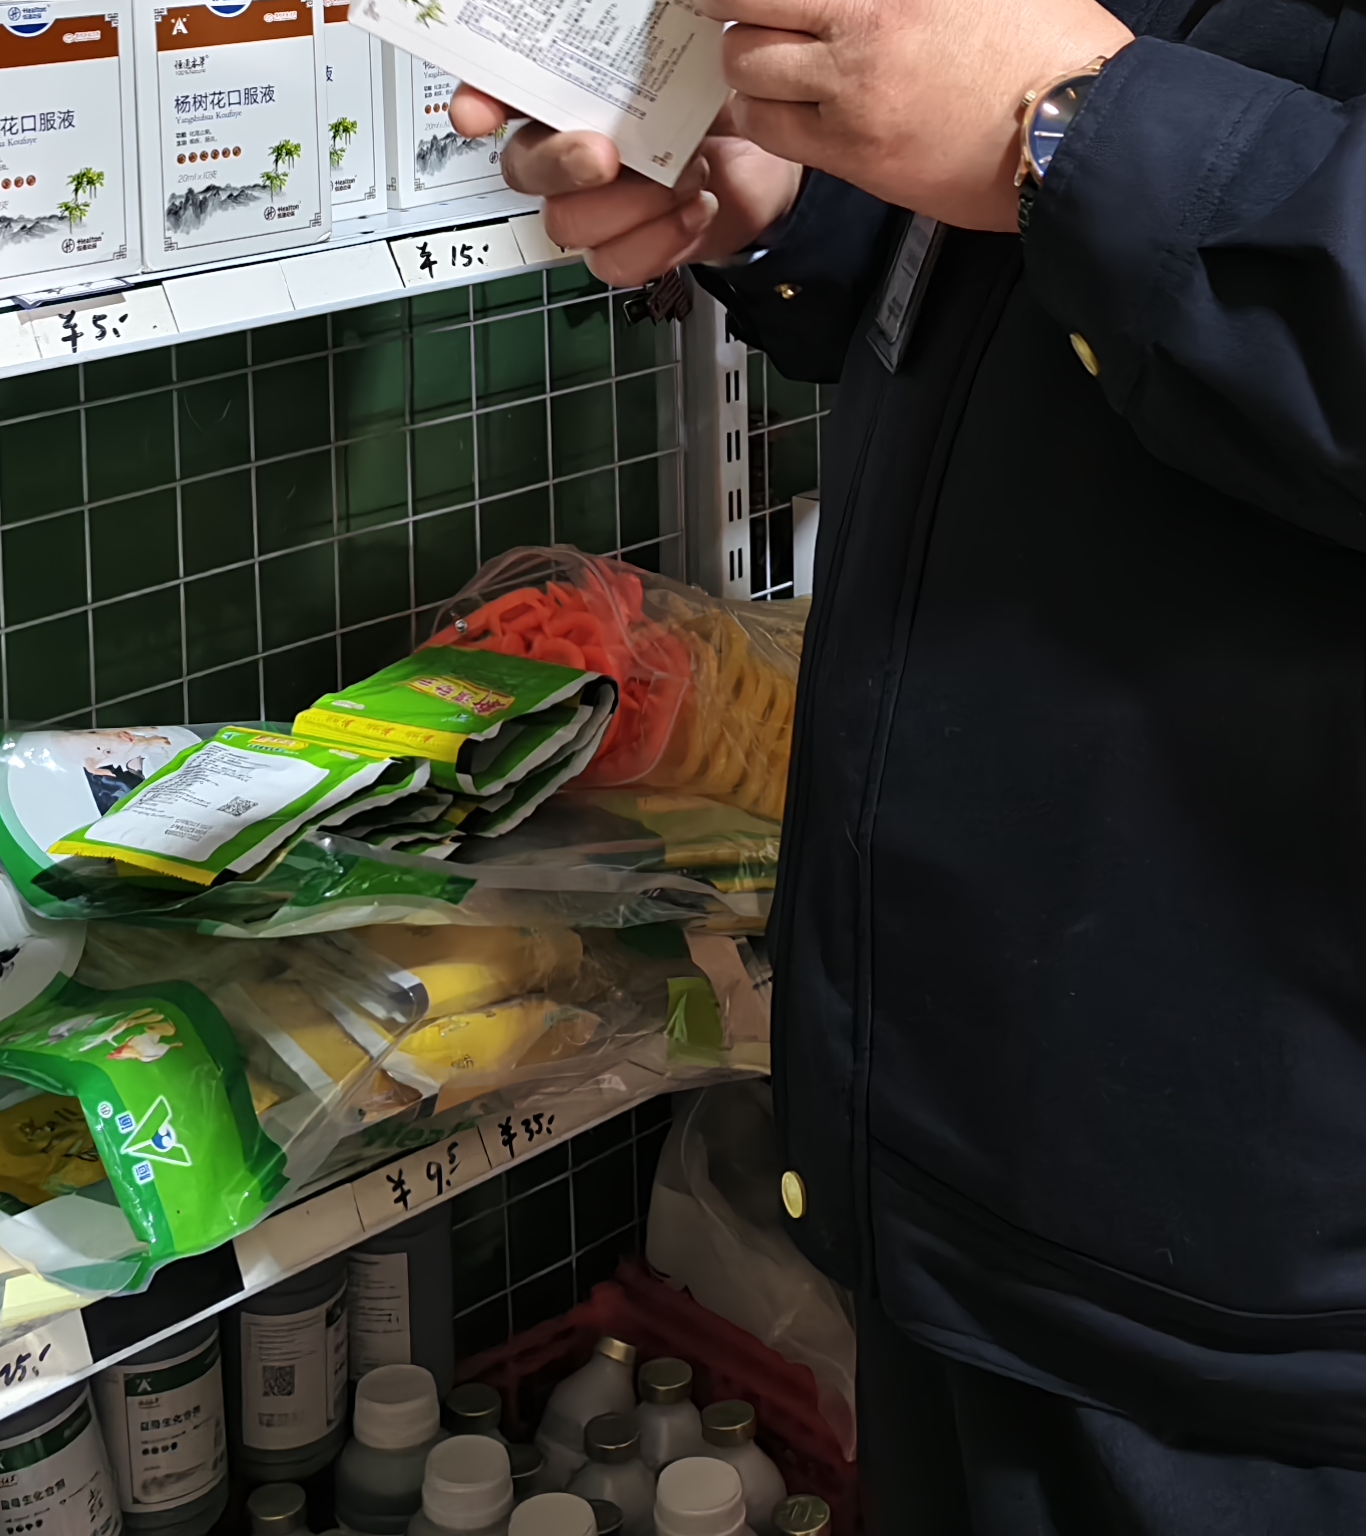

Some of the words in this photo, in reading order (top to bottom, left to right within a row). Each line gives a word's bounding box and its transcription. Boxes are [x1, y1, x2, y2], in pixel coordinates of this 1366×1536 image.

[174, 85, 275, 112] 杨树花口服液
